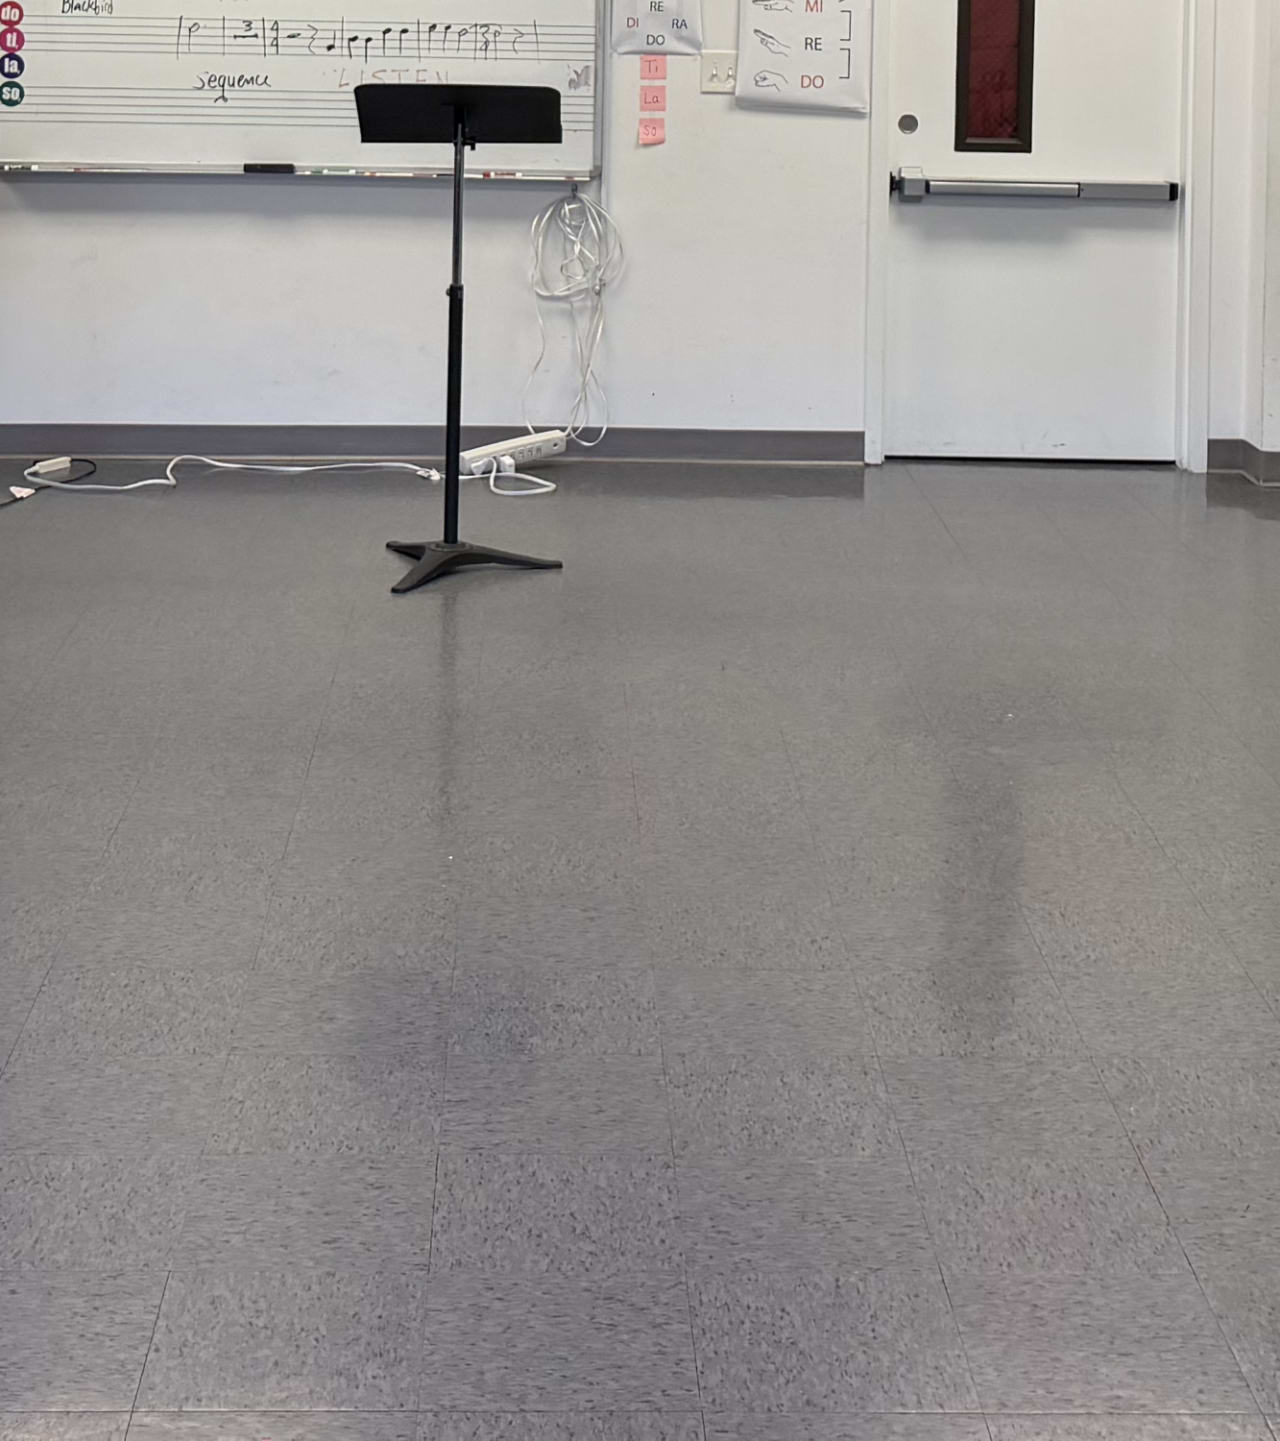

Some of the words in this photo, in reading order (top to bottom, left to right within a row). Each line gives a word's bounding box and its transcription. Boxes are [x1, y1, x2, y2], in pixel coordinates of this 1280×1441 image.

[650, 1, 664, 12] RE
[805, 0, 823, 13] MI
[1, 6, 20, 20] do
[627, 17, 639, 28] DI
[672, 18, 687, 29] RA
[646, 35, 665, 46] DO
[805, 37, 822, 51] RE
[801, 75, 824, 89] DO
[644, 93, 659, 104] La
